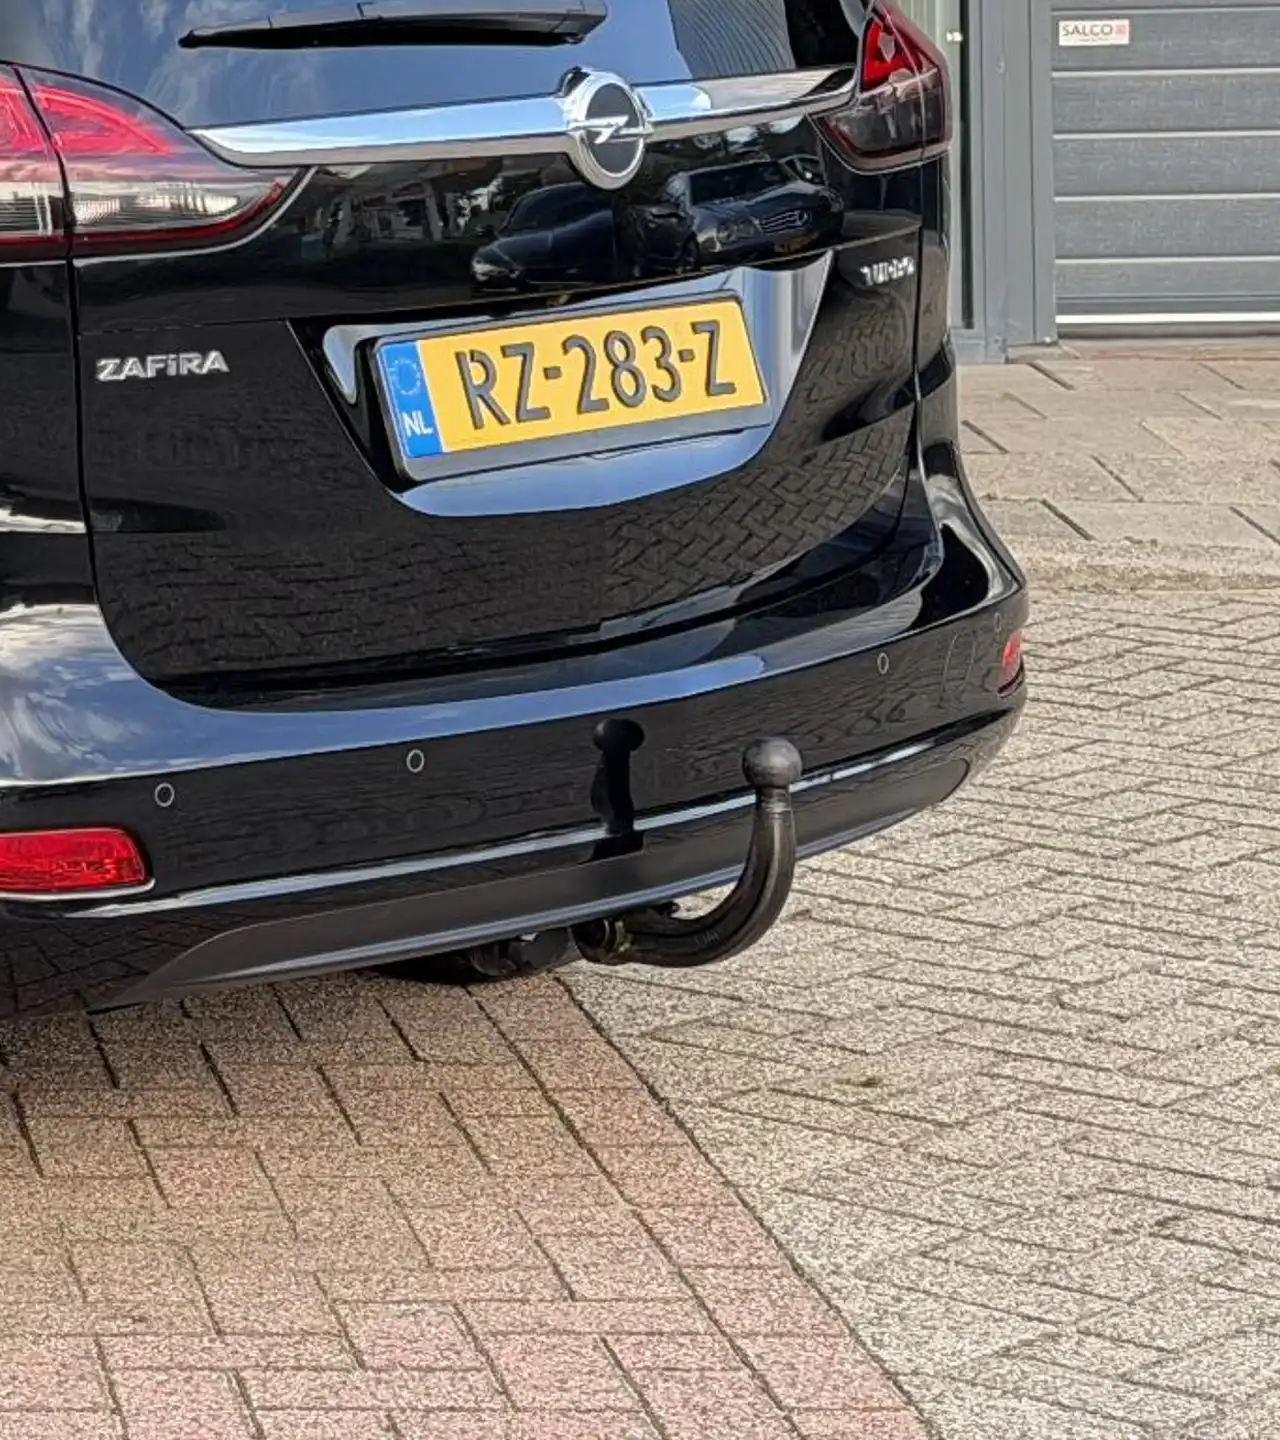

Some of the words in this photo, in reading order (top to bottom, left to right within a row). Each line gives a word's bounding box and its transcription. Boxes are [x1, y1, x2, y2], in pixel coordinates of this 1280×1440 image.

[1062, 23, 1113, 37] SALCO
[402, 410, 433, 437] NL
[454, 318, 737, 430] RZ-283-Z
